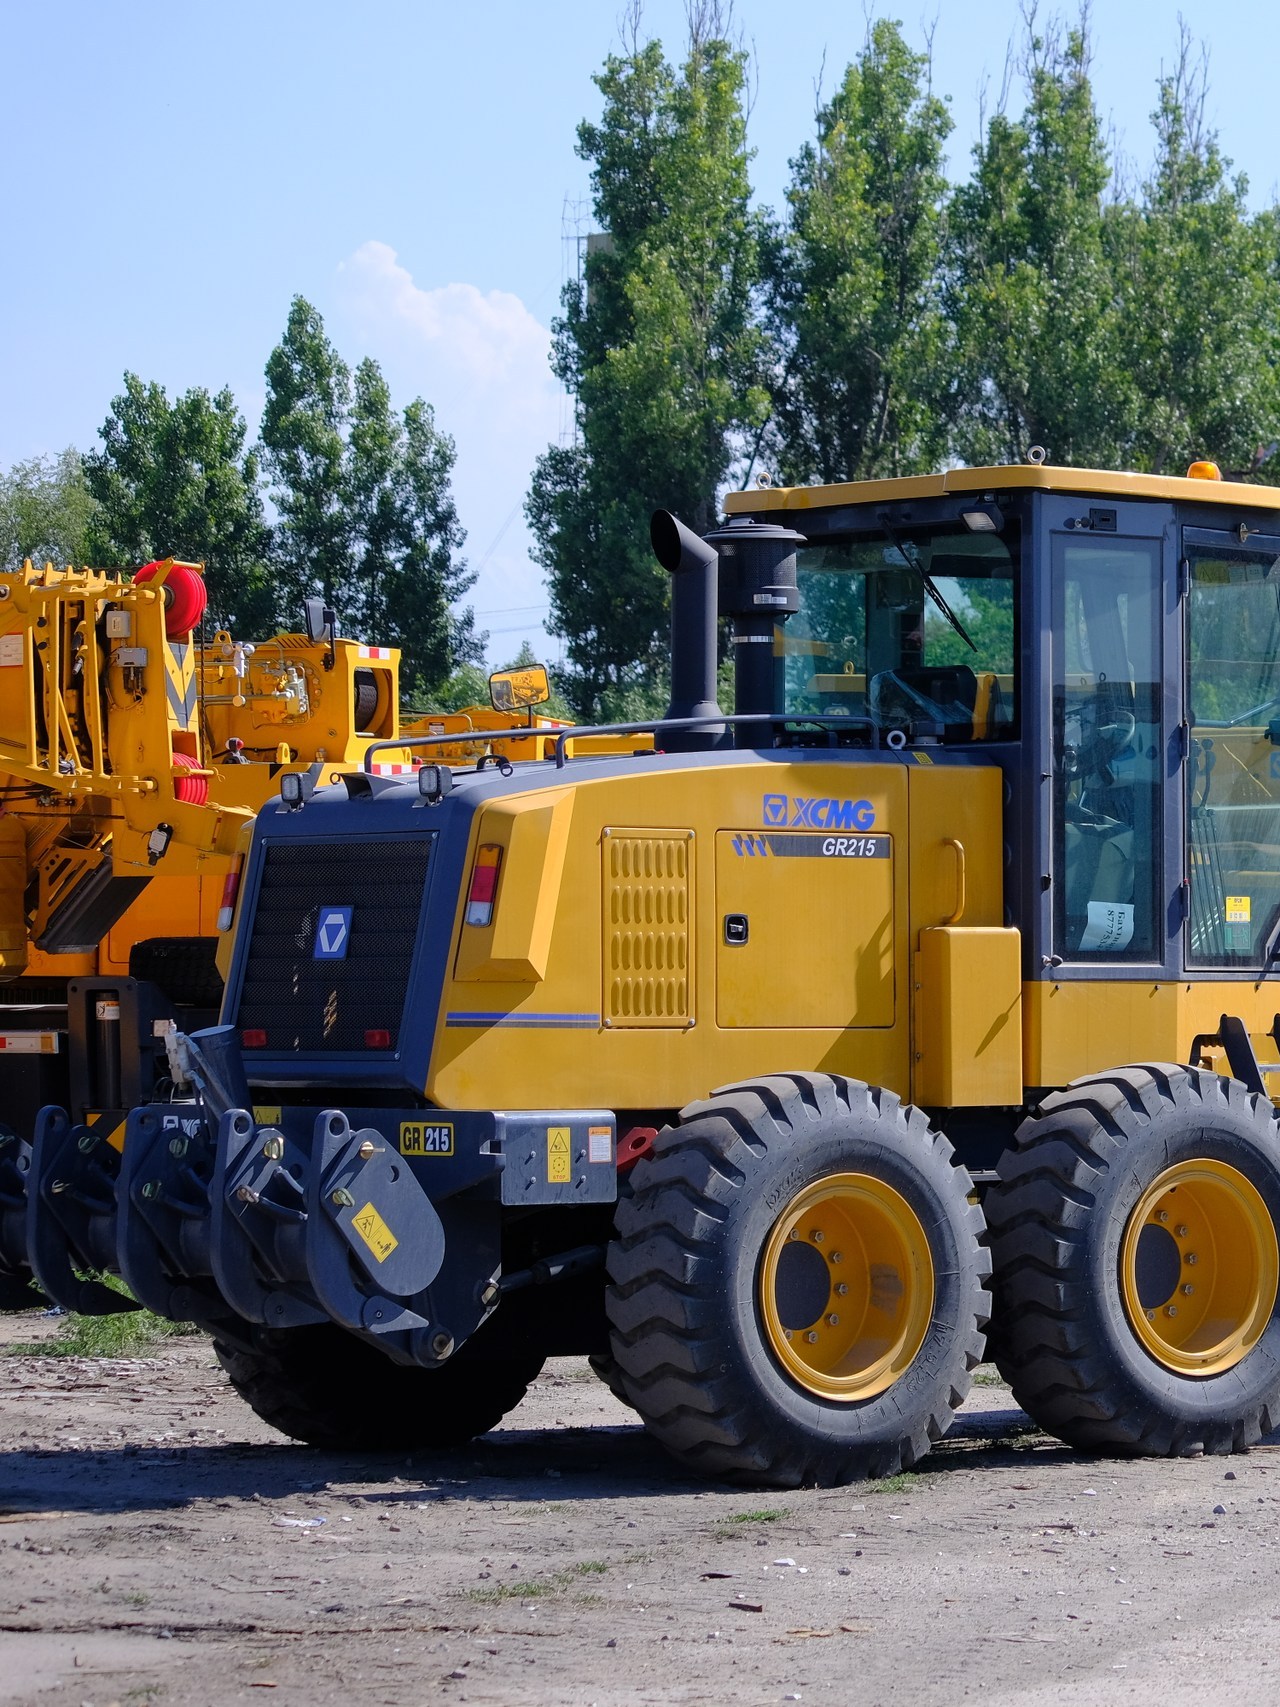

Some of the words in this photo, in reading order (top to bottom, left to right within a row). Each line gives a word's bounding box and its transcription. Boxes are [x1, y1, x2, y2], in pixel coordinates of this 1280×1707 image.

[789, 798, 875, 831] XCMG
[822, 838, 876, 857] GR215
[403, 1126, 421, 1151] GR
[425, 1127, 449, 1152] 215
